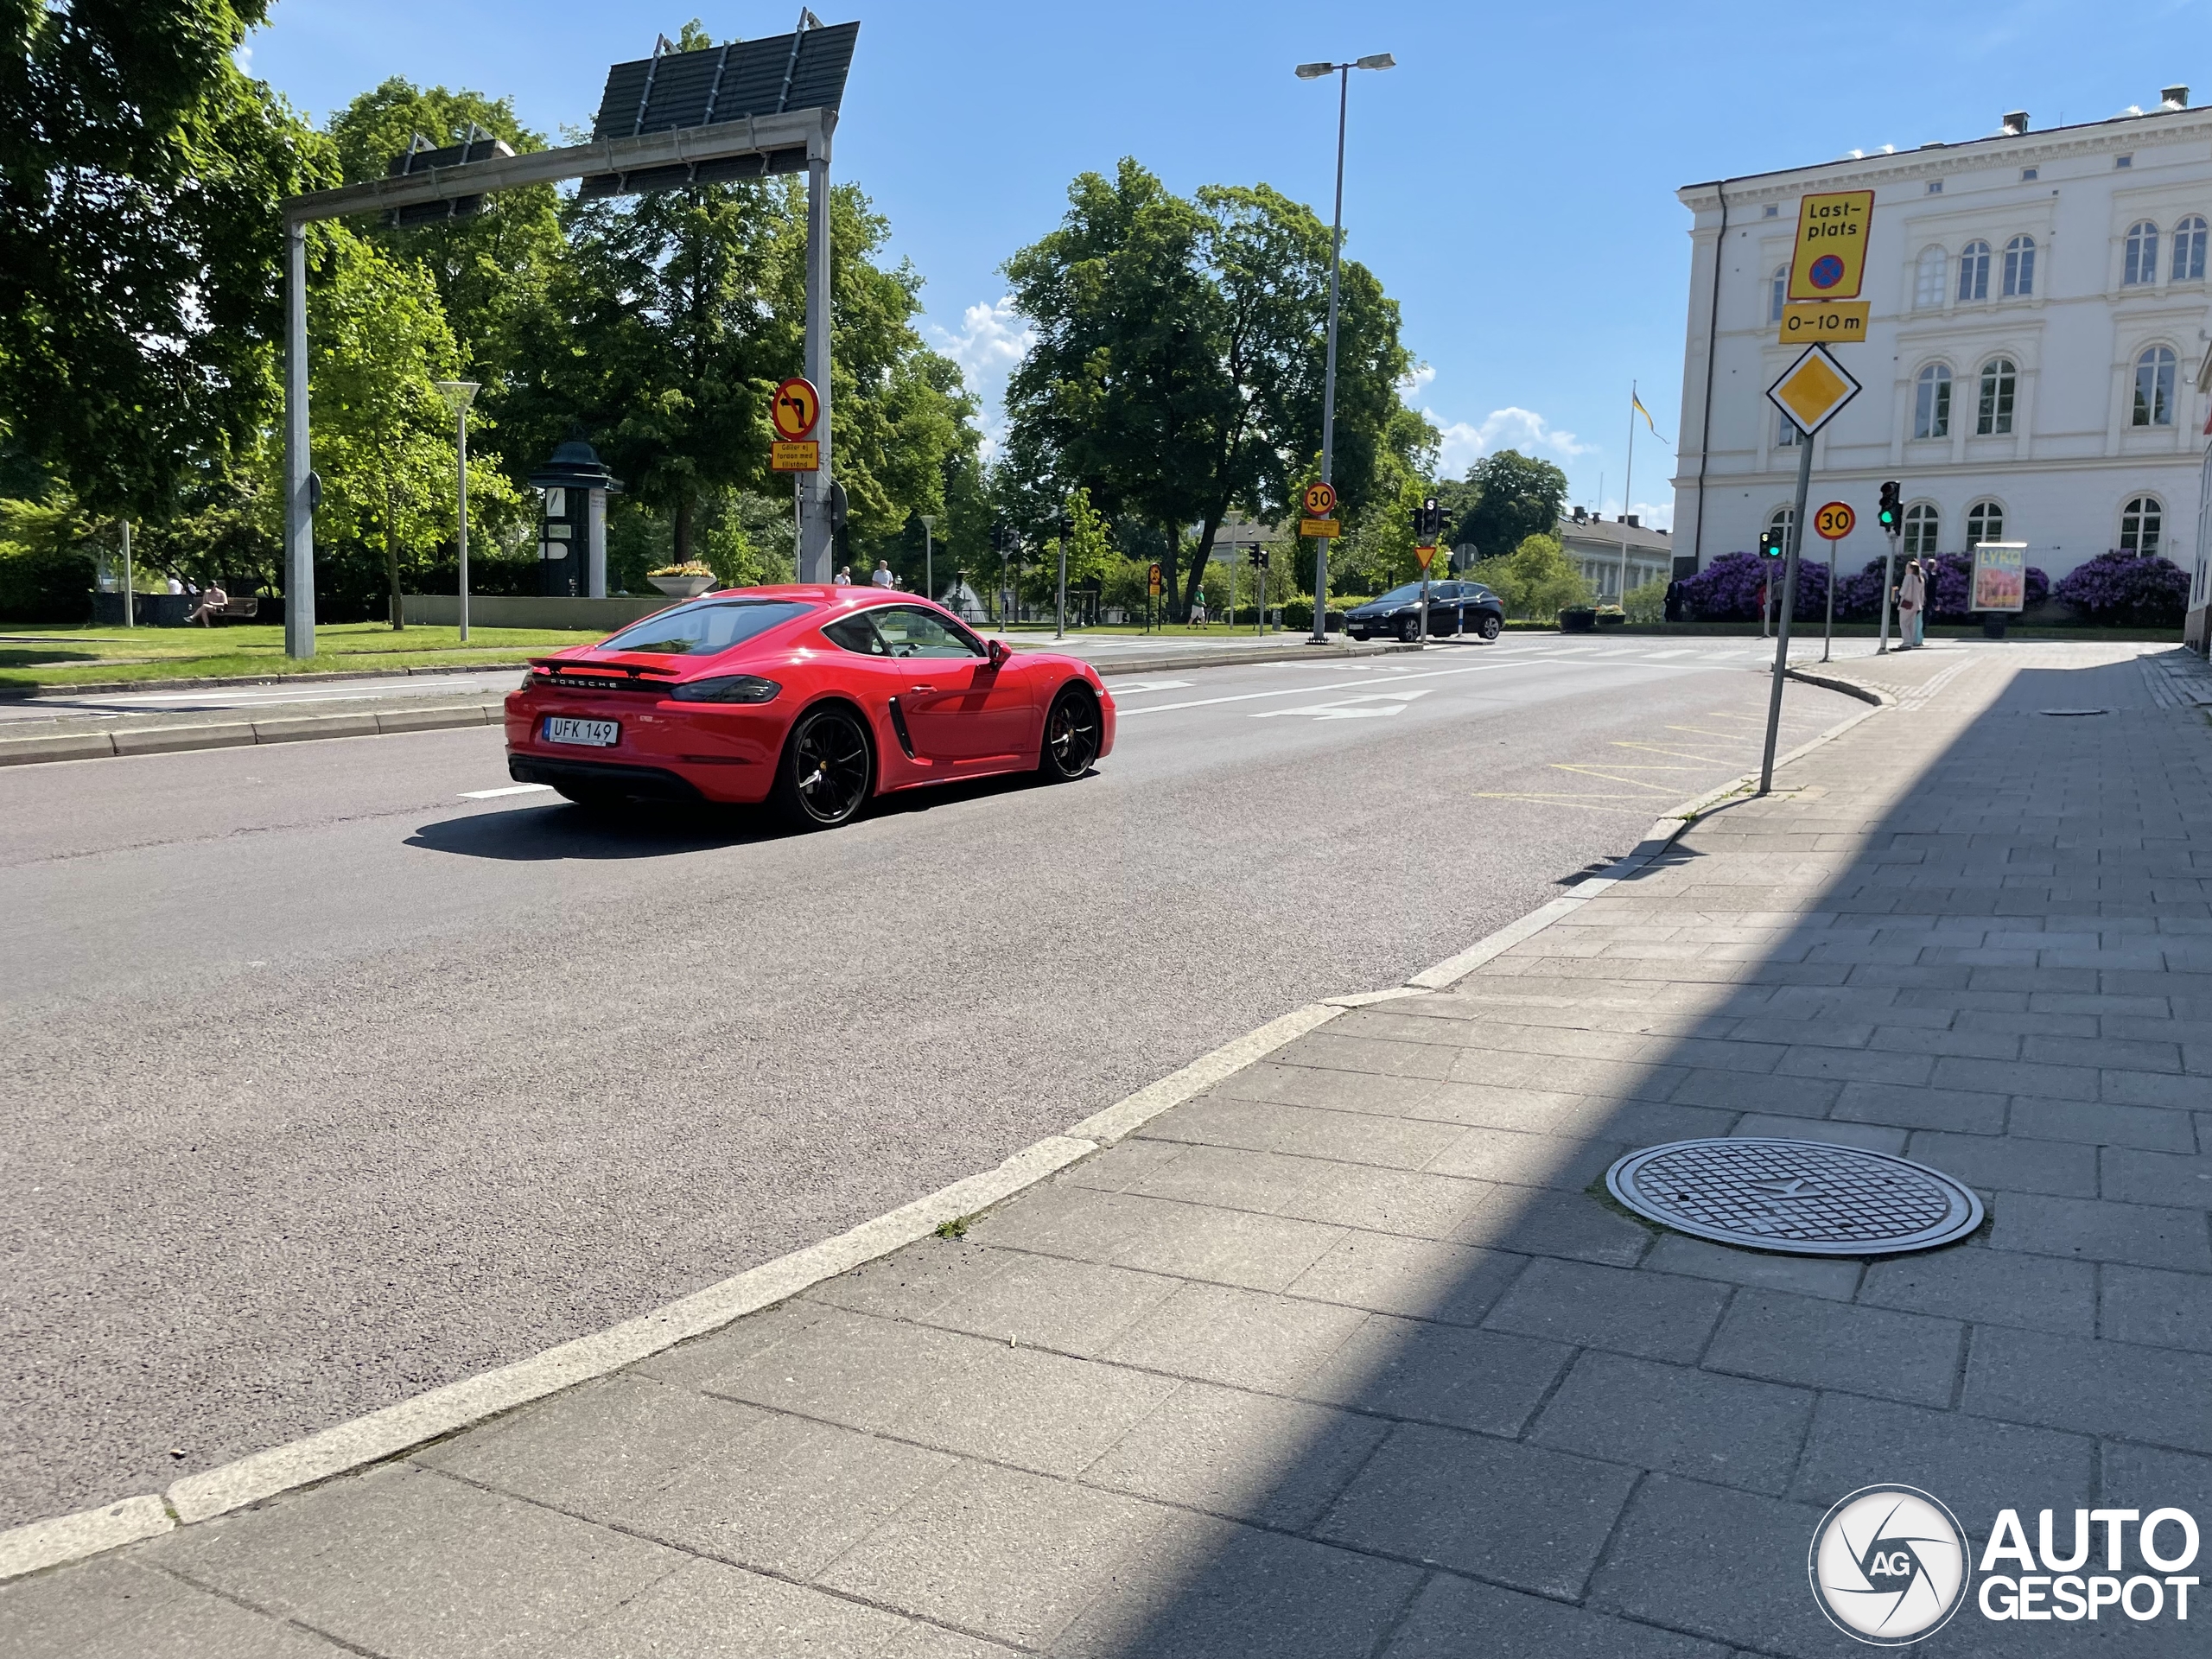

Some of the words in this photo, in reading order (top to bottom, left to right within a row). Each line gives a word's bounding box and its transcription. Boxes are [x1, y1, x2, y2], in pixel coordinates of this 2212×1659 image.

[1809, 200, 1862, 219] Last-
[1808, 222, 1858, 242] plats
[1788, 315, 1840, 331] 0-10
[1844, 316, 1860, 329] m
[1309, 491, 1331, 507] 30
[1821, 511, 1849, 531] 30
[550, 678, 618, 689] PORSCHE
[554, 719, 581, 738] UFK
[586, 722, 612, 741] 149
